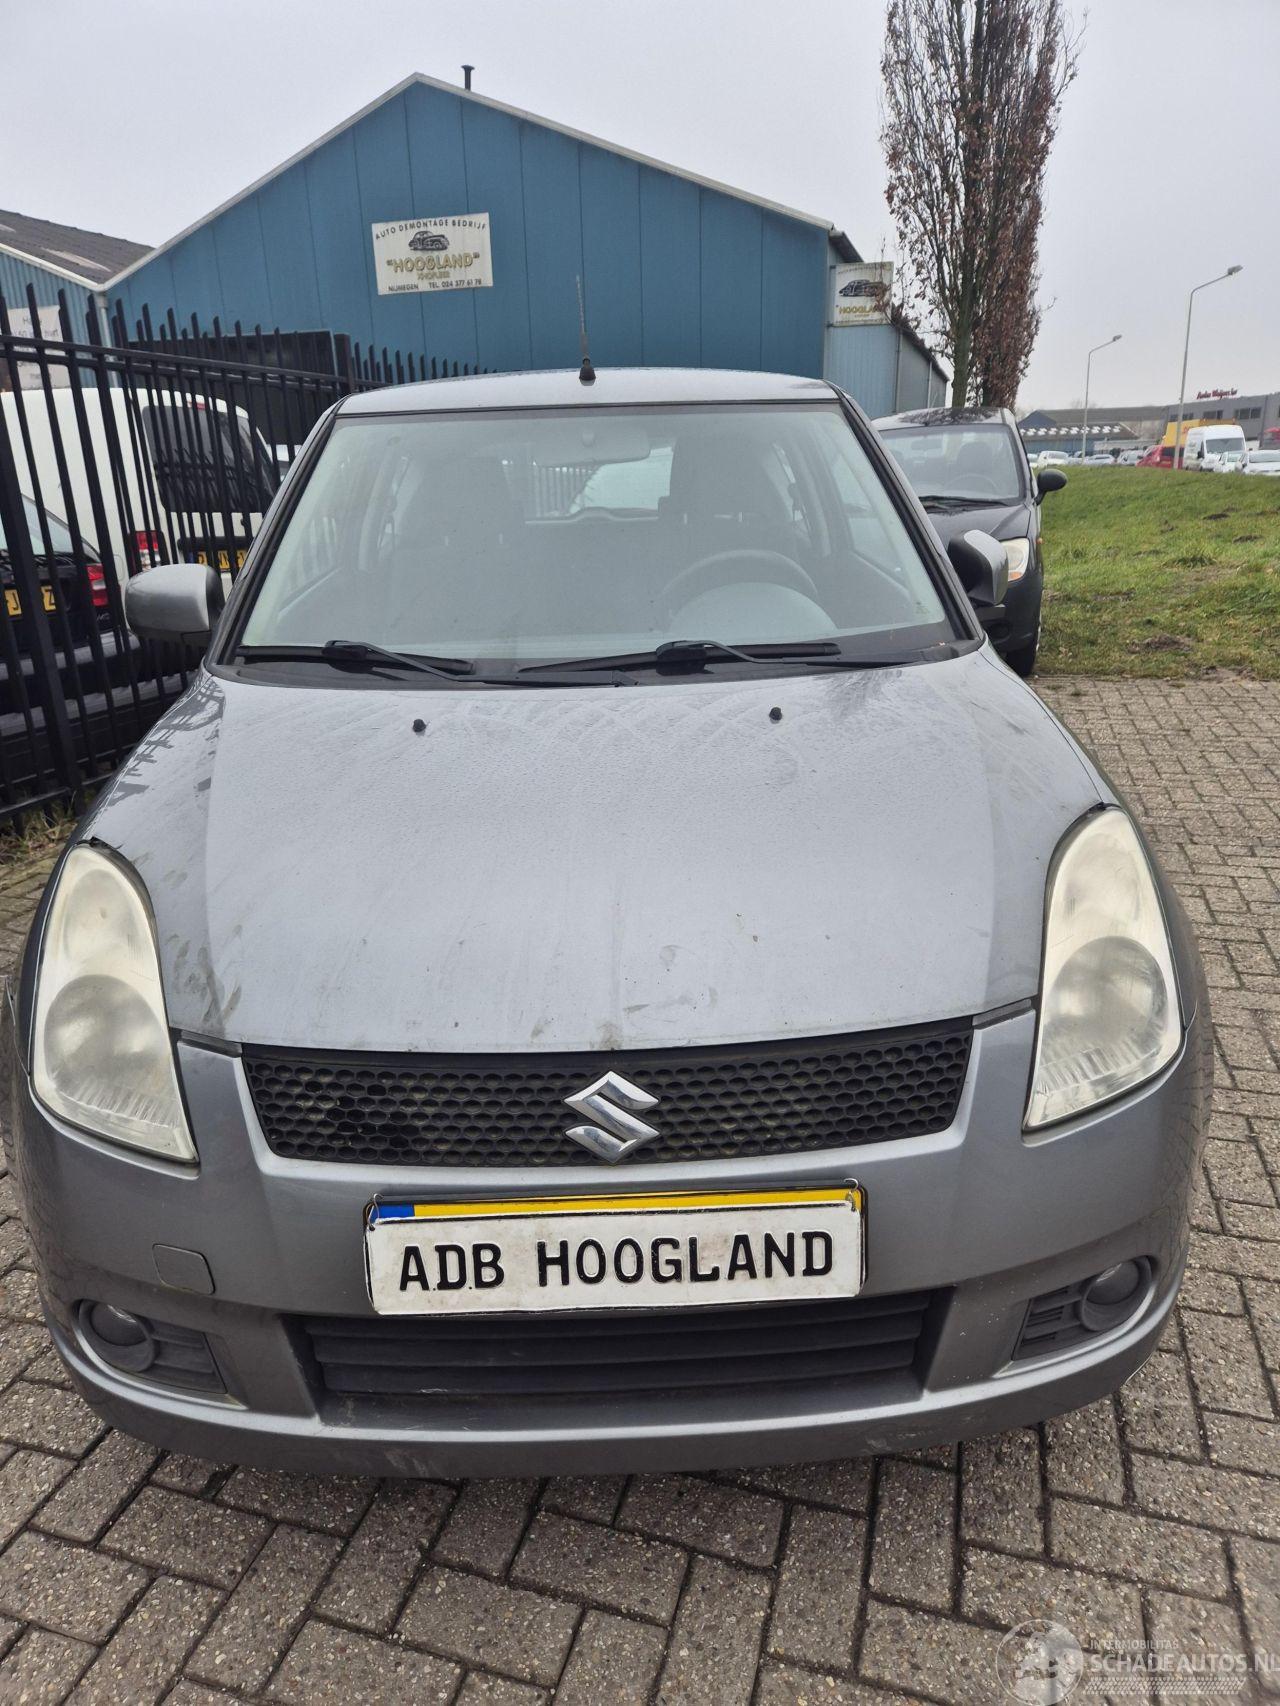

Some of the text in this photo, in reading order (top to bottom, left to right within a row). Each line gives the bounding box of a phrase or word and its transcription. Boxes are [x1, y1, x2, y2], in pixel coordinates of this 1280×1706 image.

[375, 219, 487, 240] AUTO DEMONTAGE BEDRIJF
[536, 1230, 834, 1287] HOOGLAND
